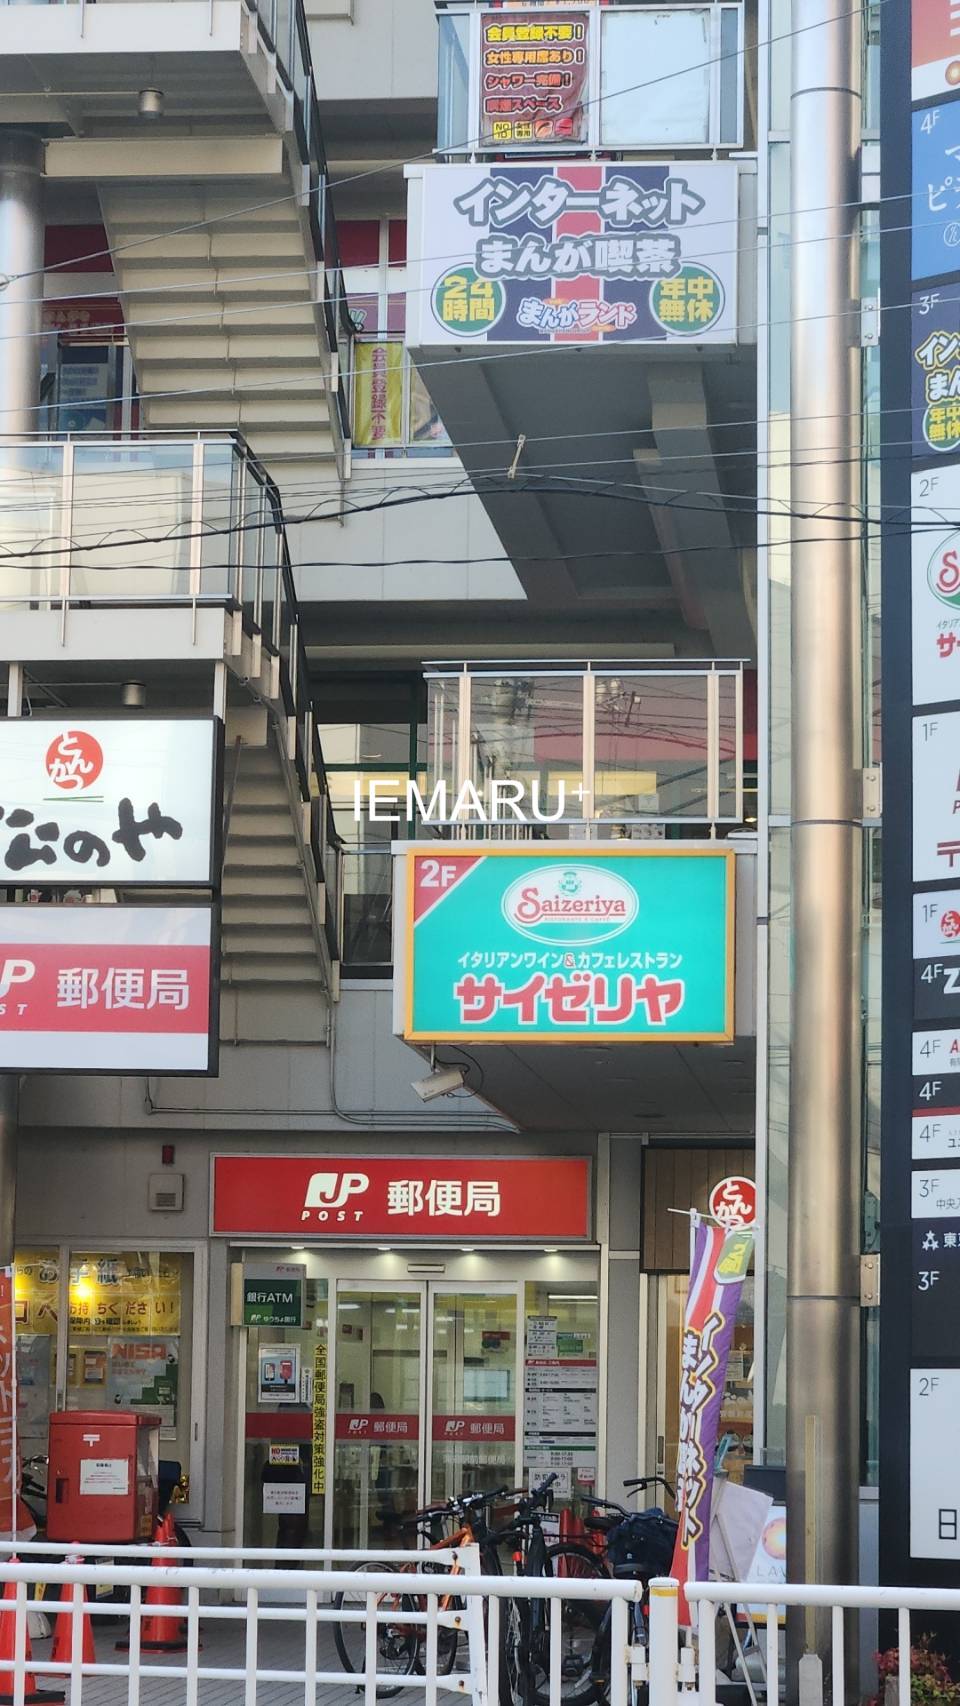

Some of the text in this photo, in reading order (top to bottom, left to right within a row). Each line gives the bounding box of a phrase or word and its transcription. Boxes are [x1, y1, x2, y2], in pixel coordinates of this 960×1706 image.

[920, 110, 940, 134] 4F
[454, 175, 706, 229] インターネット
[473, 233, 681, 281] まんが喫茶
[443, 276, 494, 299] 24
[658, 277, 714, 299] 年中
[442, 299, 494, 322] 時間
[516, 298, 638, 330] まんがランド
[658, 299, 714, 323] 無休
[918, 293, 940, 315] 3F
[371, 347, 388, 440] 会員登録不要
[919, 476, 939, 497] 2F
[922, 722, 938, 742] 1F
[48, 732, 94, 790] とんかつ
[420, 860, 456, 887] 2F
[515, 887, 626, 921] Saizeriya
[922, 904, 938, 923] 1F
[457, 952, 683, 970] イタリアンワイン&カフェレストラン
[0, 959, 36, 999] P
[920, 963, 944, 984] 4F
[57, 967, 190, 1011] 郵便局
[453, 972, 685, 1026] サイゼリヤ
[919, 1039, 941, 1059] 4F
[919, 1081, 941, 1101] 4F
[919, 1123, 941, 1143] 4F
[947, 1137, 960, 1149] ユ
[304, 1172, 370, 1209] JP
[387, 1180, 501, 1217] 郵便局
[919, 1178, 939, 1198] 3F
[715, 1181, 753, 1226] とんかつ
[300, 1210, 365, 1222] POST
[943, 1232, 960, 1248] 東
[918, 1270, 939, 1291] 3F
[247, 1292, 294, 1303] 銀行ATM
[919, 1377, 939, 1396] 2F
[313, 1344, 328, 1493] 全国郵便局強盗対策強化中
[349, 1419, 369, 1431] JP
[373, 1422, 408, 1433] 郵便局
[445, 1420, 465, 1432] JP
[470, 1423, 505, 1434] 郵便局
